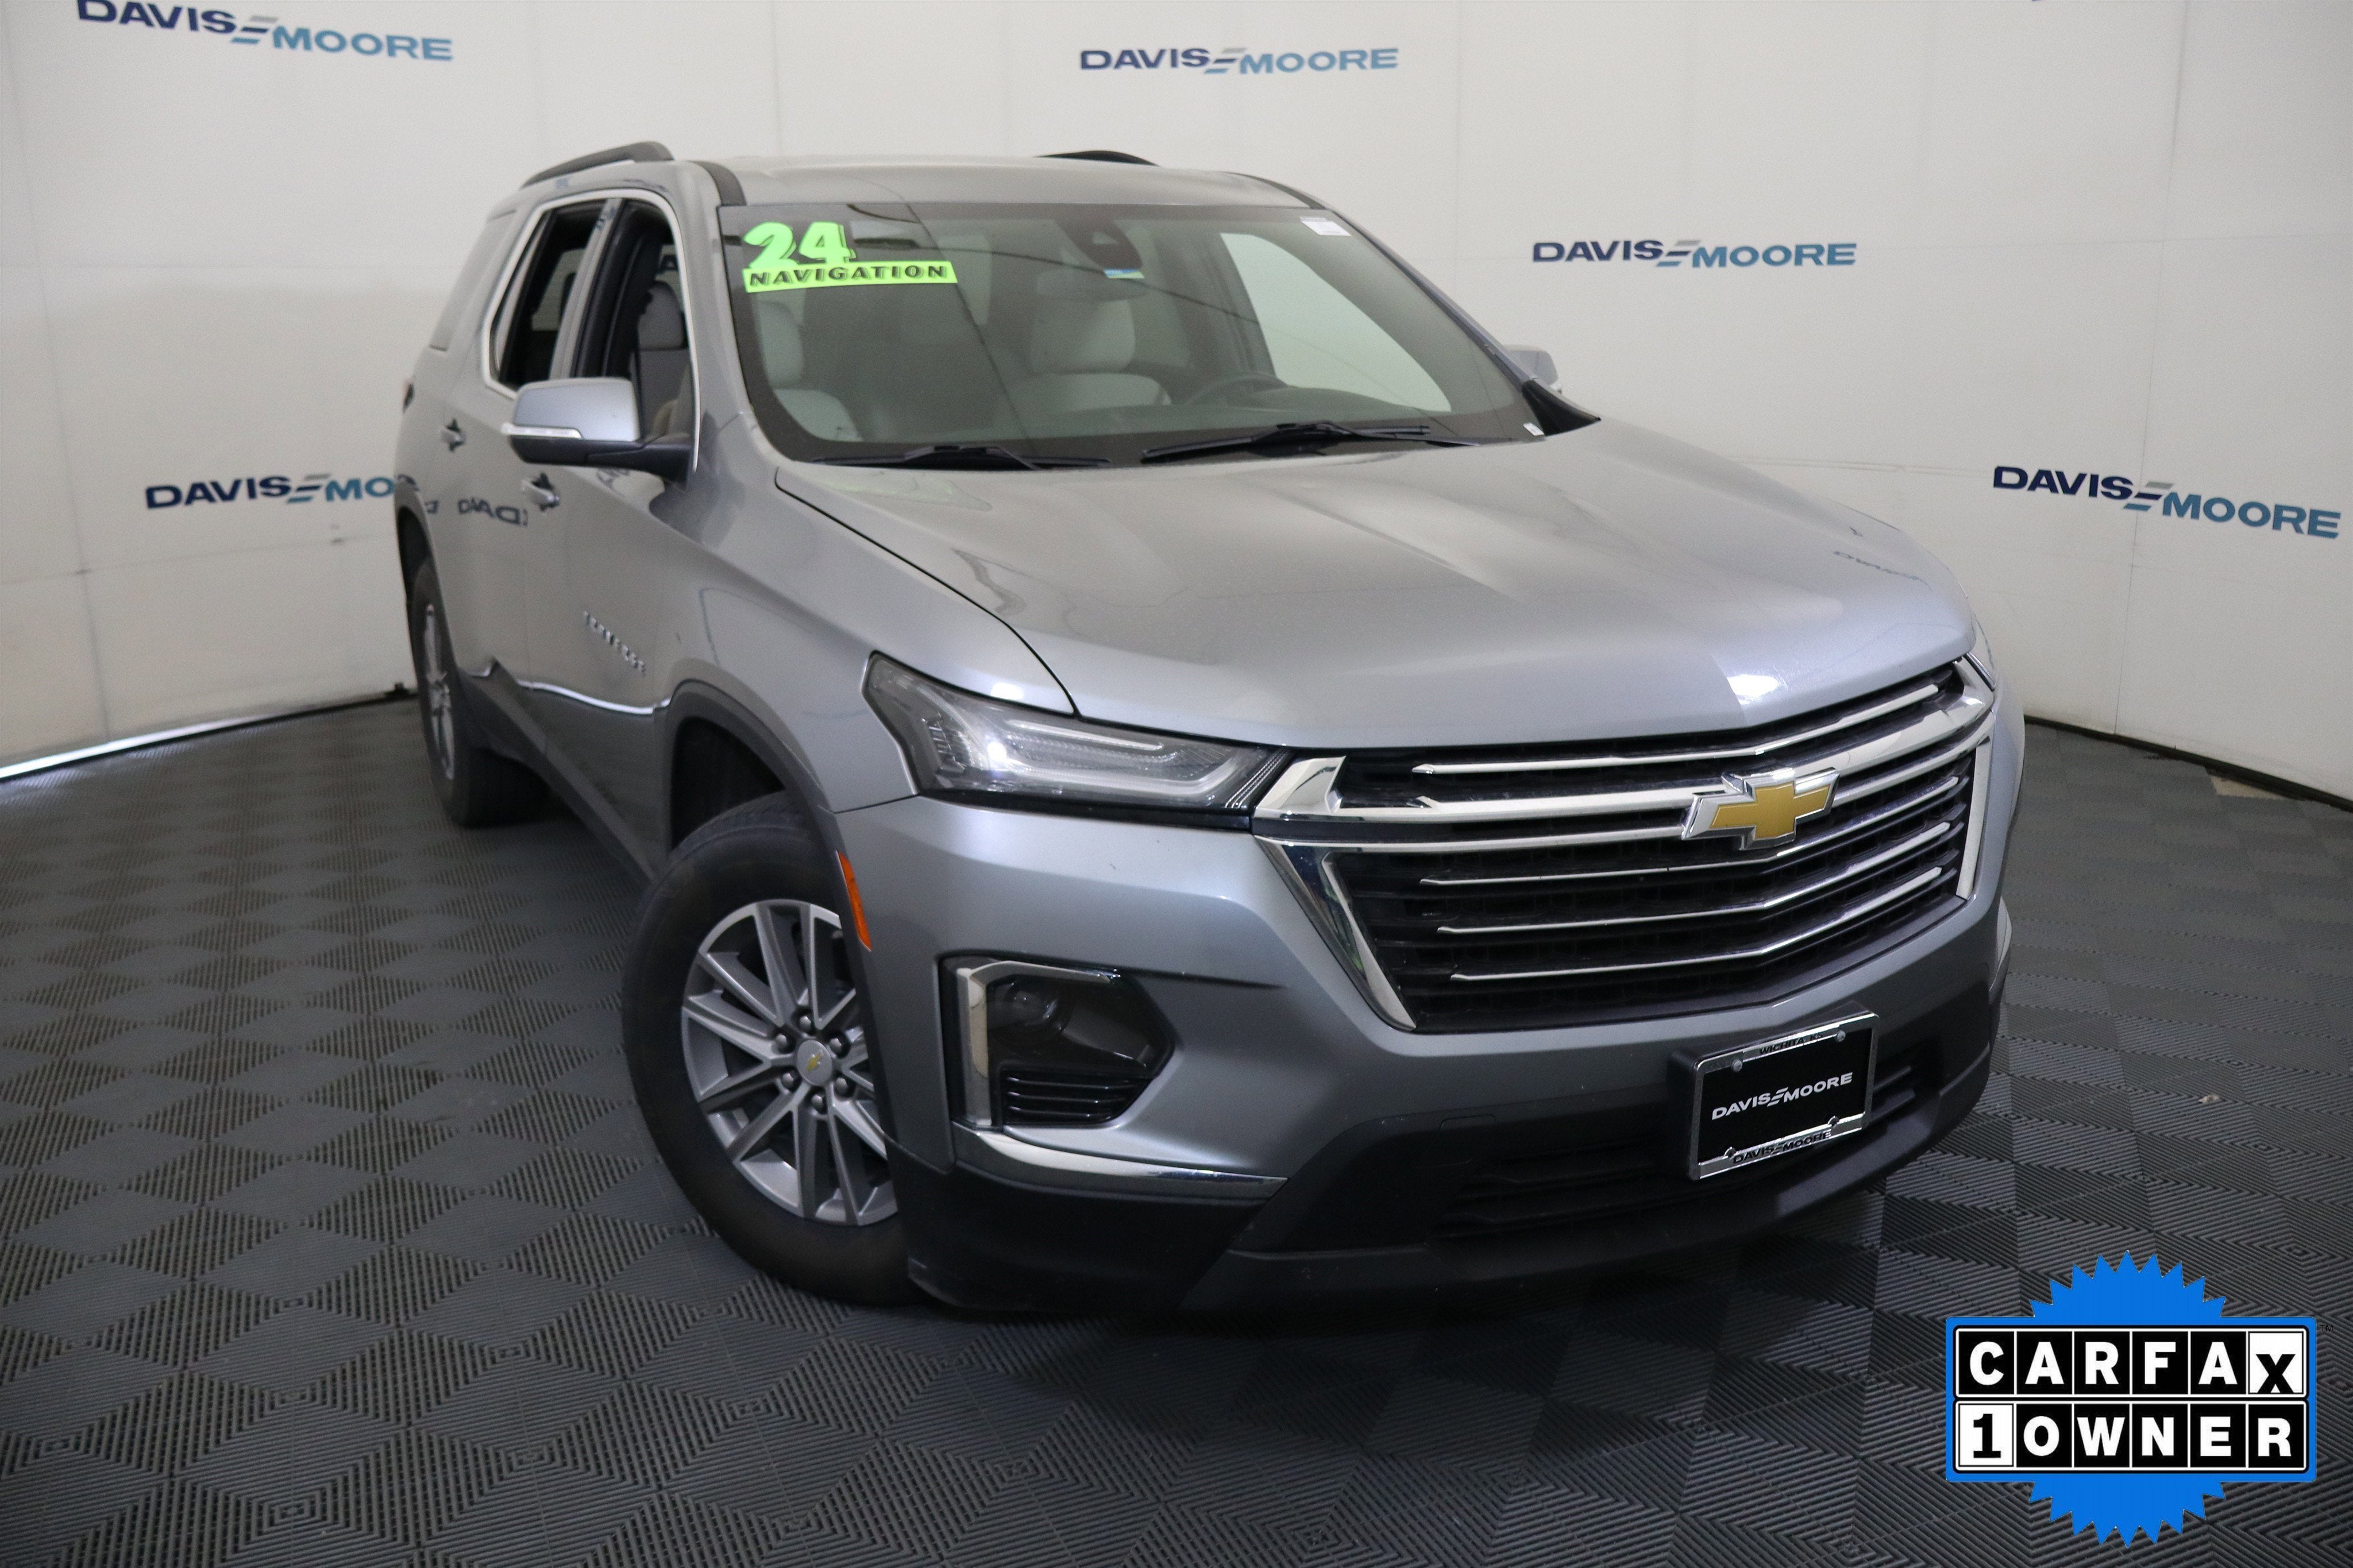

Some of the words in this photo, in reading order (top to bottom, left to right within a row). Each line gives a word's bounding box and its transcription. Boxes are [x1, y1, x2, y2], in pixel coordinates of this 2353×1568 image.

[77, 0, 237, 34] DAVIS
[273, 26, 453, 61] MOORE
[1081, 48, 1209, 69] DAVIS
[1239, 48, 1399, 75] MOORE
[743, 222, 856, 270] 24
[1533, 240, 1663, 262] DAVIS
[1692, 244, 1857, 268] MOORE
[750, 265, 947, 287] NAVIGATION
[146, 476, 291, 509] DAVIS
[325, 477, 395, 501] MO
[1993, 466, 2133, 500] DAVIS
[2163, 492, 2342, 539] MOORE
[1712, 1092, 1771, 1120] DAVIS
[1784, 1072, 1853, 1103] MOORE
[1733, 1145, 1775, 1164] DAVIS
[1783, 1129, 1831, 1152] MOORE
